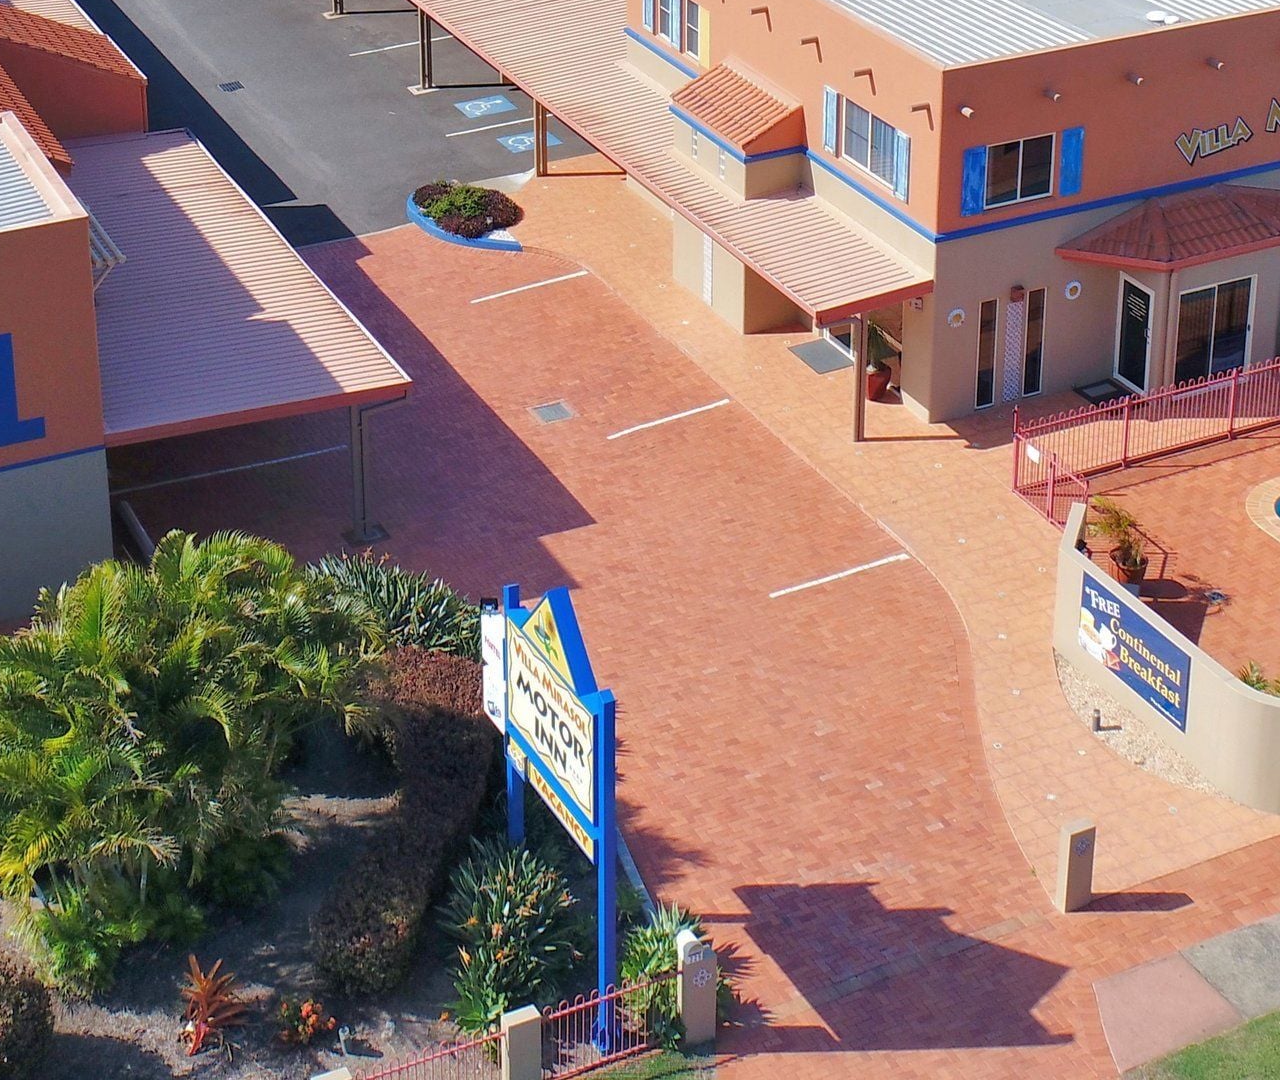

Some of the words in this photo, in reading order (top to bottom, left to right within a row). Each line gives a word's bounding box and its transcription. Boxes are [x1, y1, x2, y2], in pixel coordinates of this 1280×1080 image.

[1175, 115, 1254, 166] VILLA
[1110, 618, 1181, 687] Continental
[1120, 646, 1181, 709] Breakfast
[513, 636, 540, 683] VILLA
[542, 672, 587, 739] MIRASOL
[517, 670, 585, 767] MOTOR
[535, 716, 567, 773] INN
[533, 768, 590, 850] VACANCY
